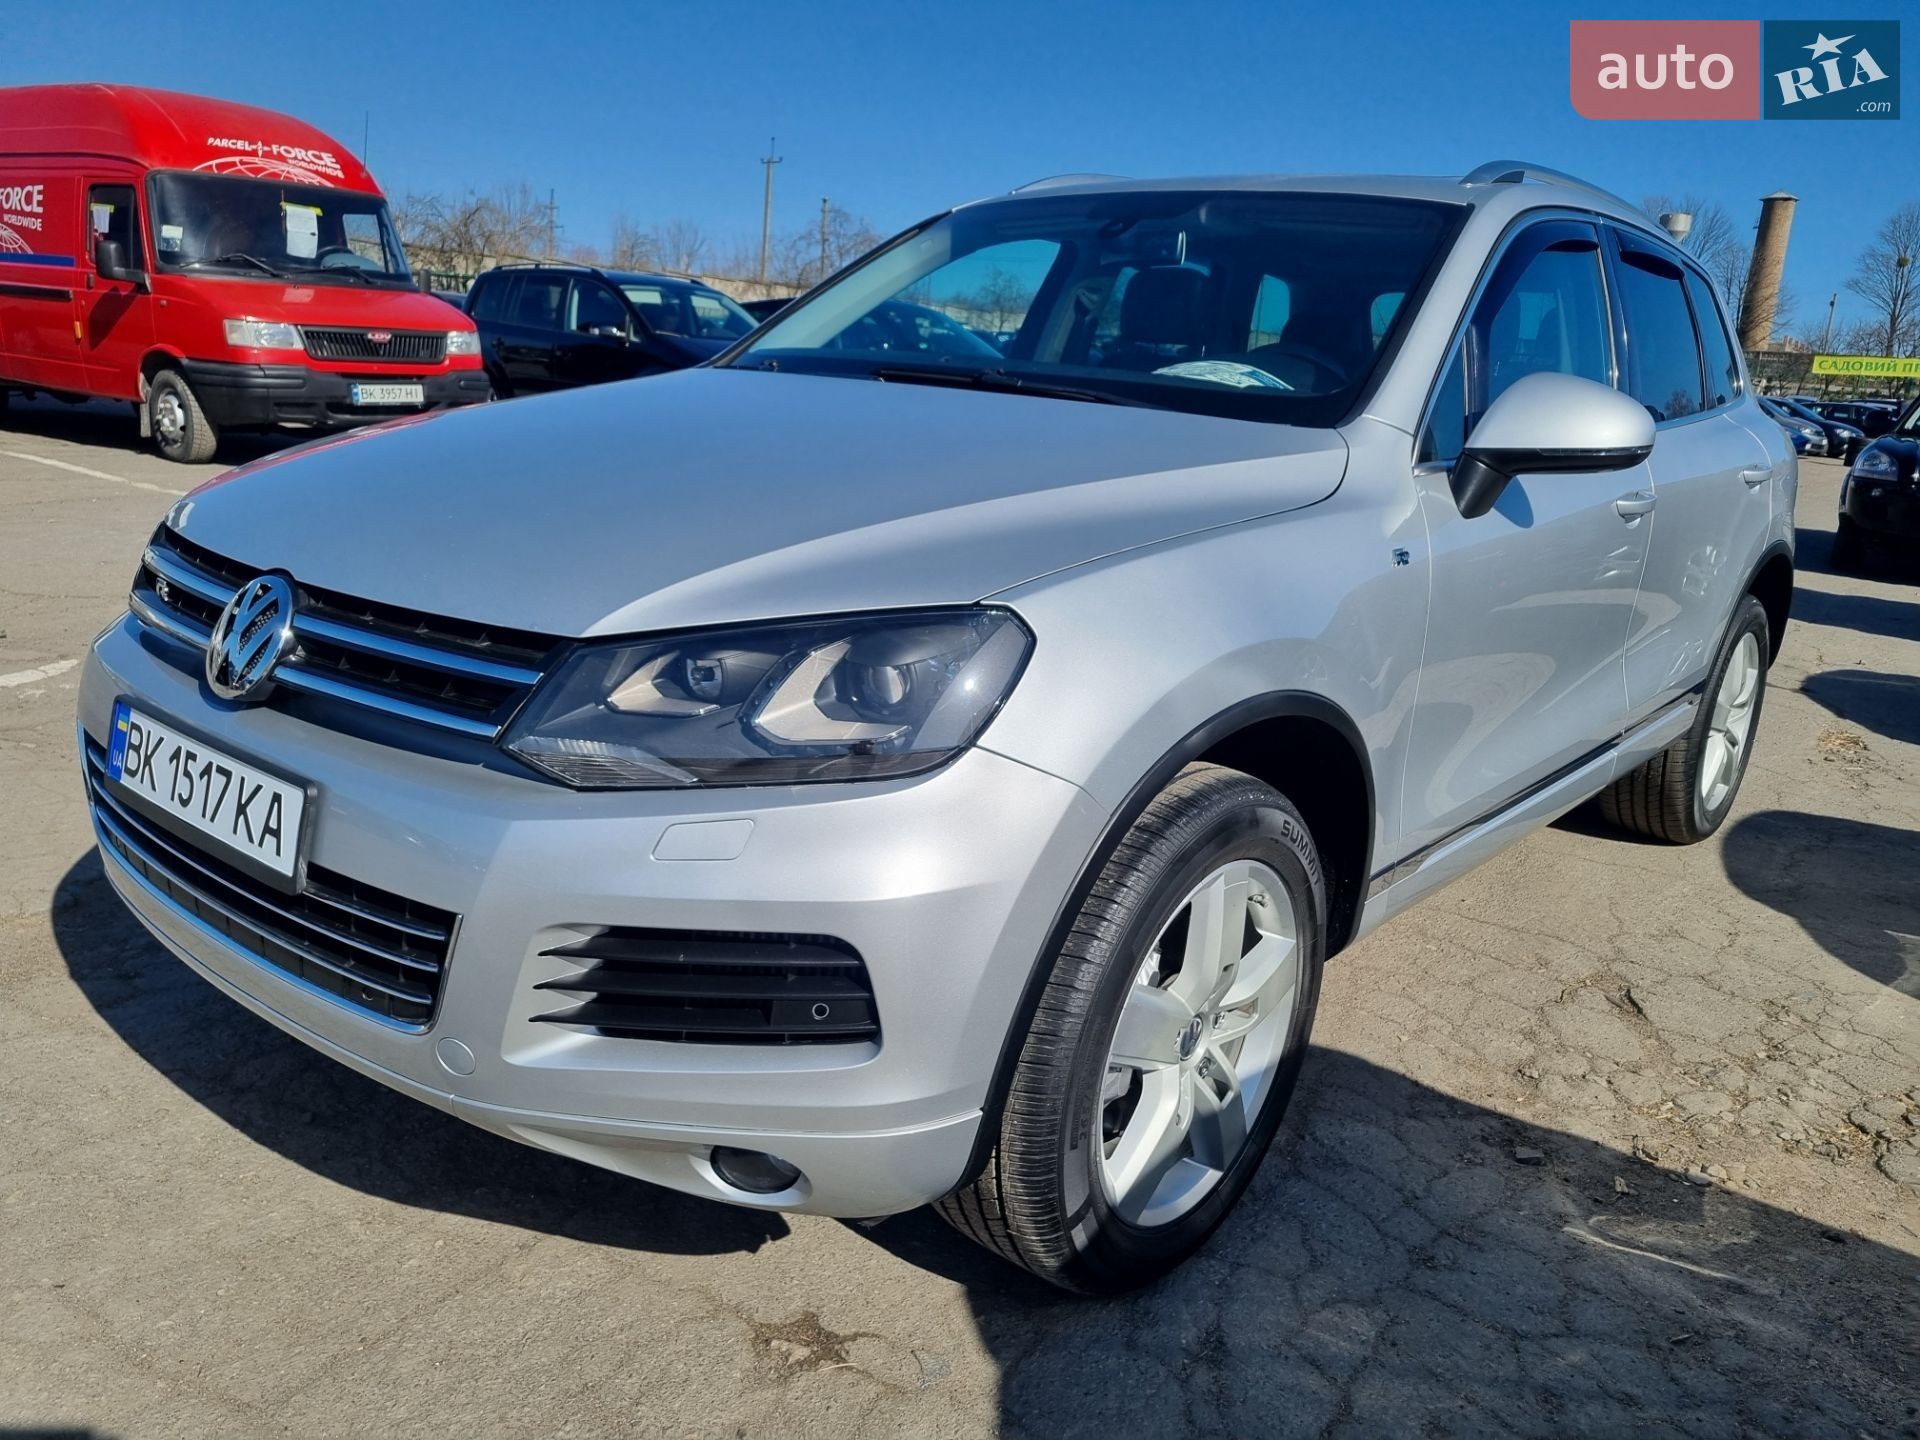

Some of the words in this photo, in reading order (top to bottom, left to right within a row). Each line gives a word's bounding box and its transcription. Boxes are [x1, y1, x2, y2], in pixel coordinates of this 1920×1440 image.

[207, 137, 252, 151] PARCEL
[271, 144, 341, 169] FORCE
[288, 158, 345, 179] WORLDWIDE
[3, 213, 42, 231] WORLDWIDE
[1819, 359, 1897, 372] САДОВИЙ
[361, 388, 376, 400] BK
[380, 388, 402, 400] 3957
[112, 753, 122, 769] UA
[124, 721, 164, 793] BK
[169, 745, 233, 824] 1517
[233, 776, 283, 857] KA
